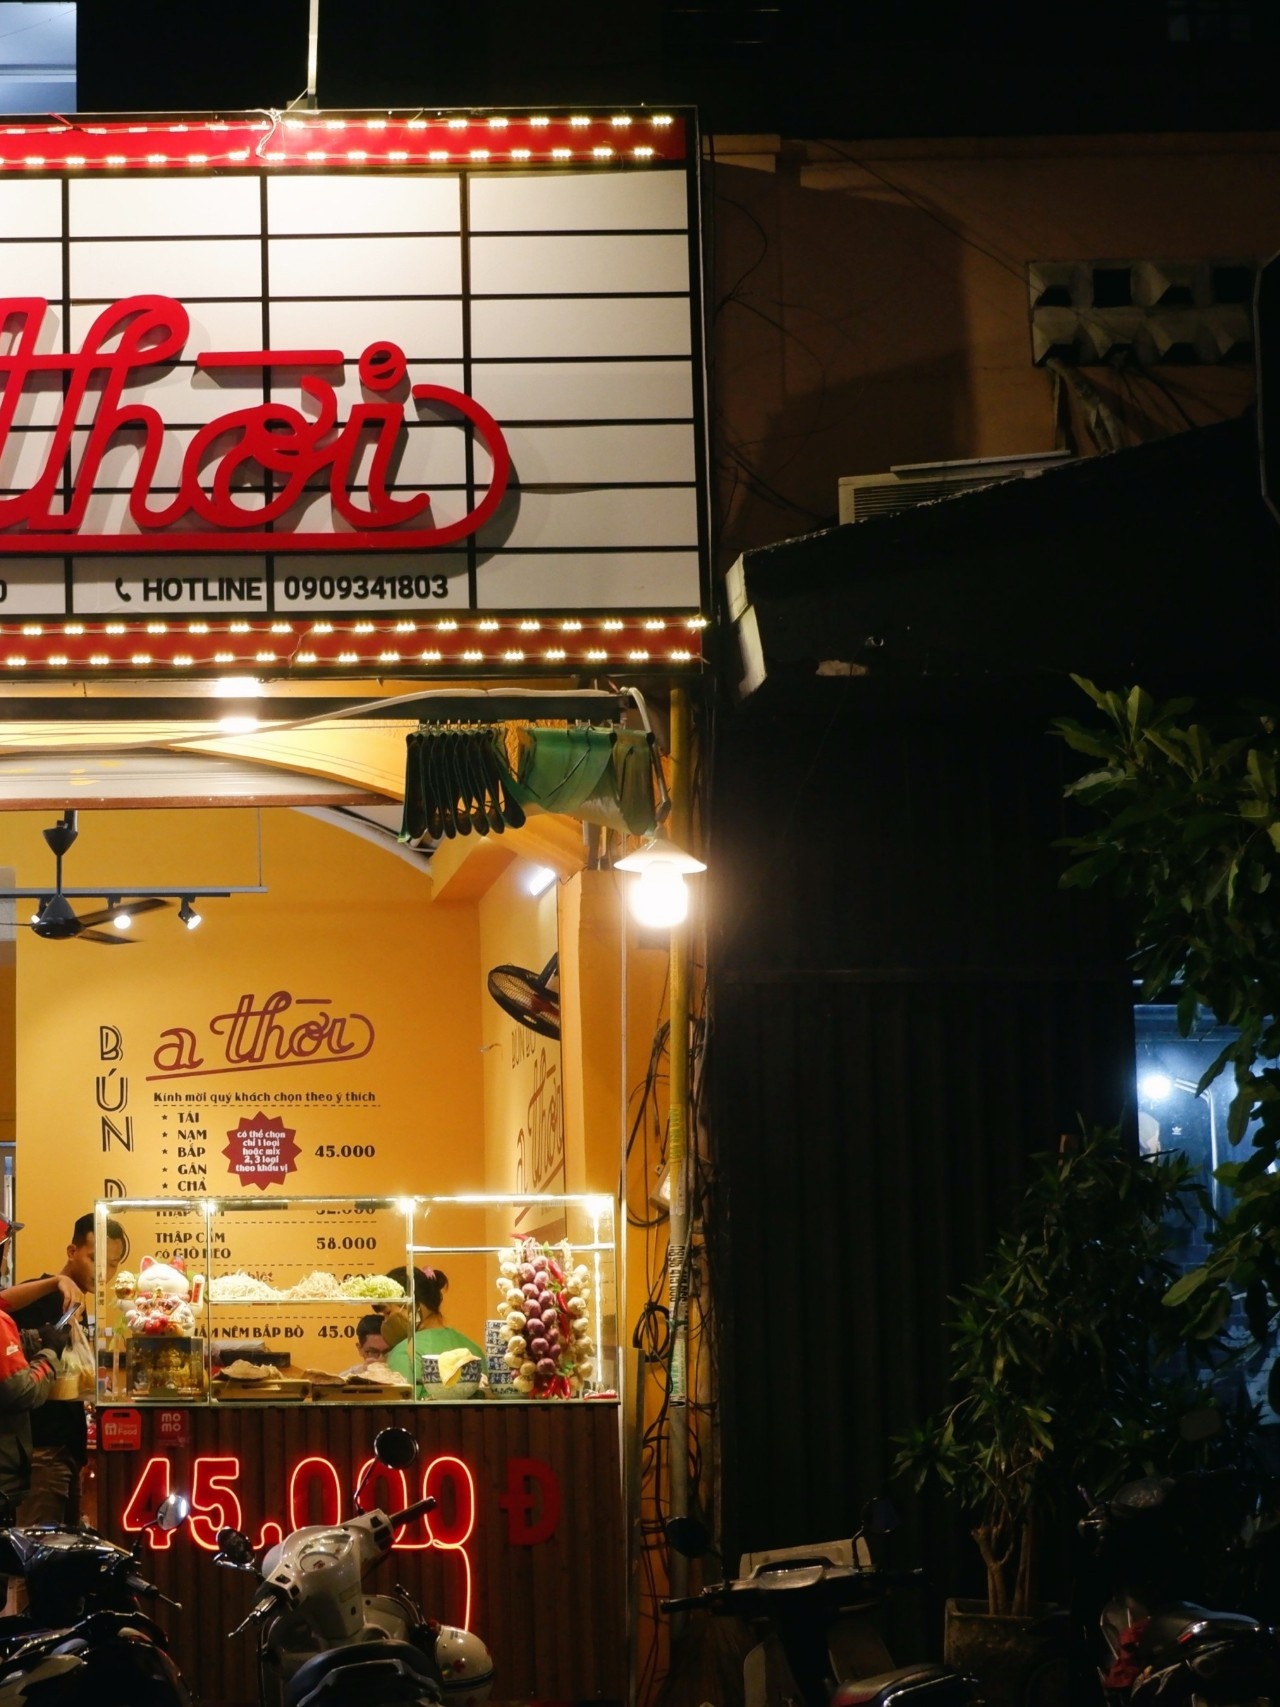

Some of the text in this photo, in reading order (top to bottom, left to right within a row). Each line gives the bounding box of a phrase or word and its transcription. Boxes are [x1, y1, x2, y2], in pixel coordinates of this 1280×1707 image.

[142, 574, 449, 601] HOTLINE 0909341803
[154, 1091, 376, 1104] Kính mời quý khách chọn theo ý thích
[177, 1110, 200, 1123] TÁI
[177, 1129, 207, 1142] NẠM
[237, 1130, 247, 1138] có
[314, 1145, 376, 1158] 45.000
[254, 1155, 261, 1164] 3
[177, 1162, 207, 1175] GÂN
[235, 1163, 256, 1172] theo
[177, 1176, 207, 1192] CHẢ
[155, 1229, 193, 1246] THẬP
[316, 1236, 377, 1250] 58.000
[173, 1245, 200, 1259] GIÒ
[221, 1324, 250, 1338] NÊM
[252, 1322, 282, 1338] BẮP
[284, 1323, 304, 1338] BÒ
[161, 1412, 182, 1422] mo
[161, 1422, 182, 1432] mo
[122, 1456, 475, 1550] 45.000
